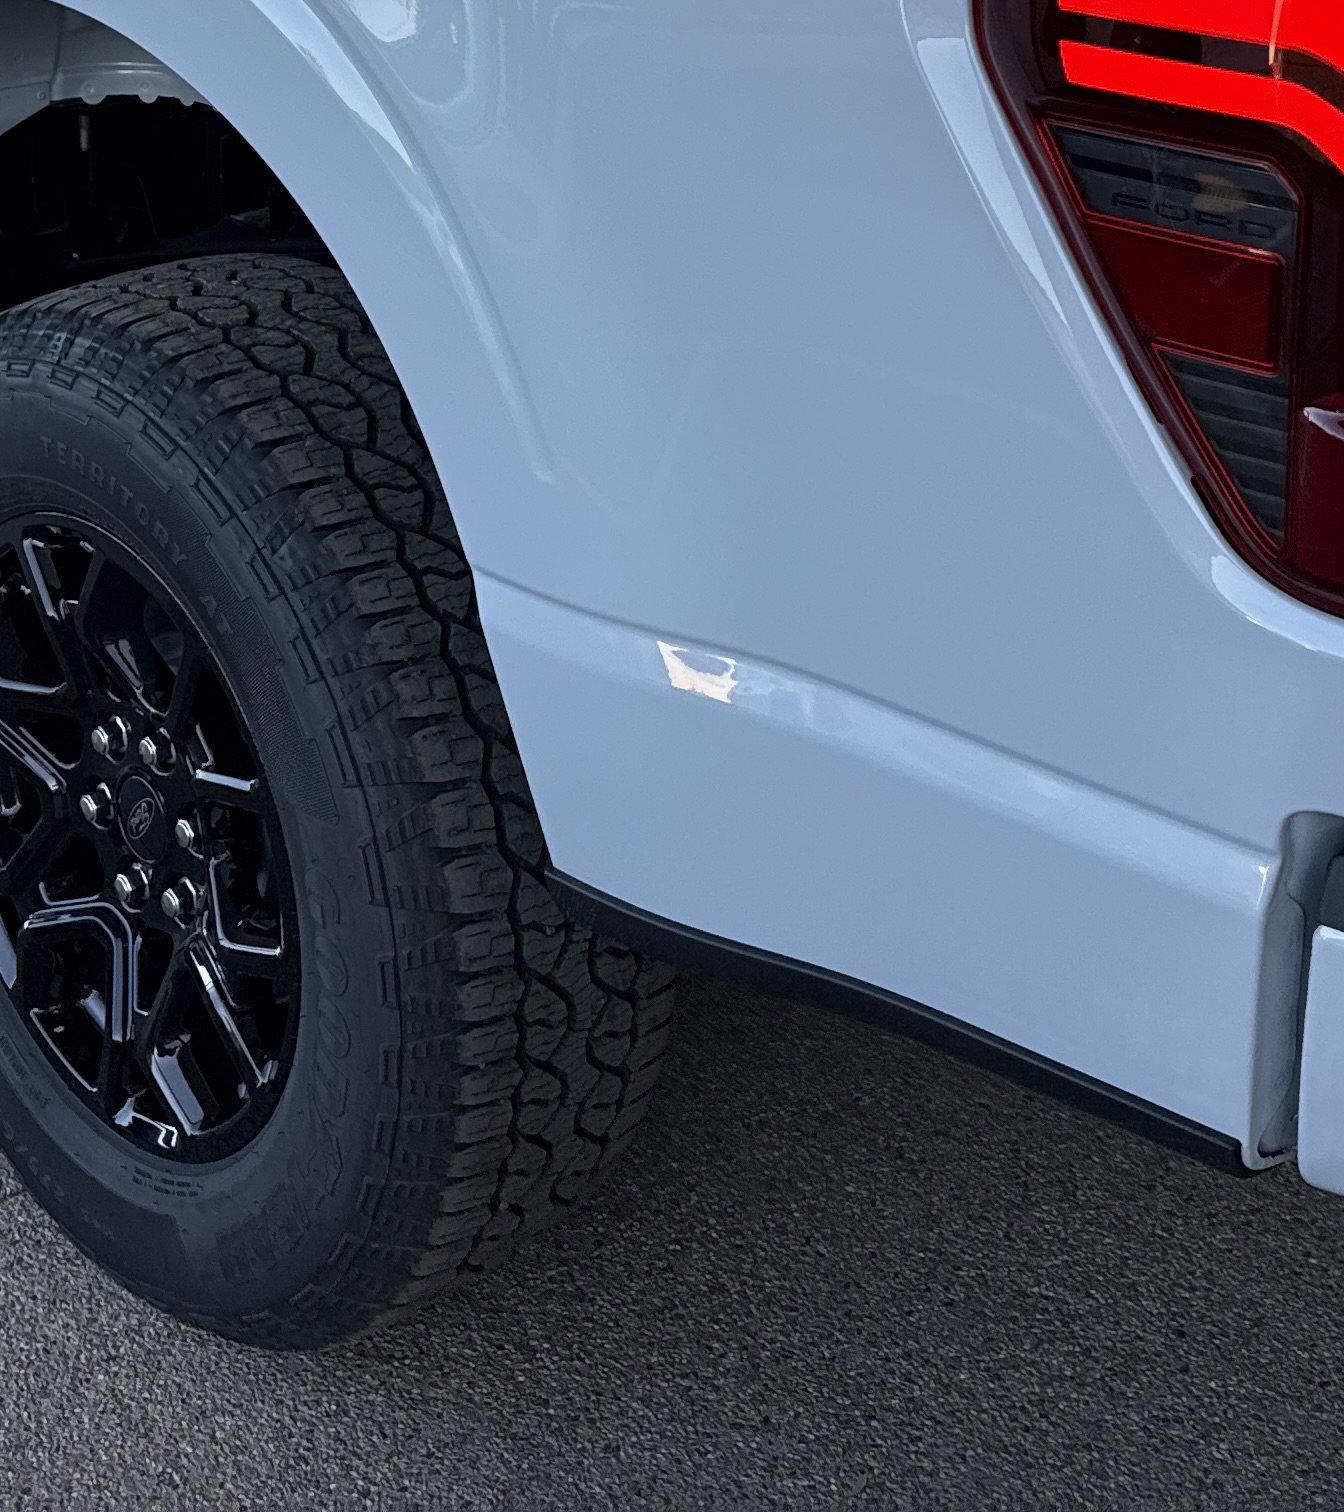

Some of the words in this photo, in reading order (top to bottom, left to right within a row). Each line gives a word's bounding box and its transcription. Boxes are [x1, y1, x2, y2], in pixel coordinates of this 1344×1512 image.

[1112, 192, 1277, 239] FORD
[39, 435, 189, 565] TERRITORY
[199, 594, 233, 635] AT
